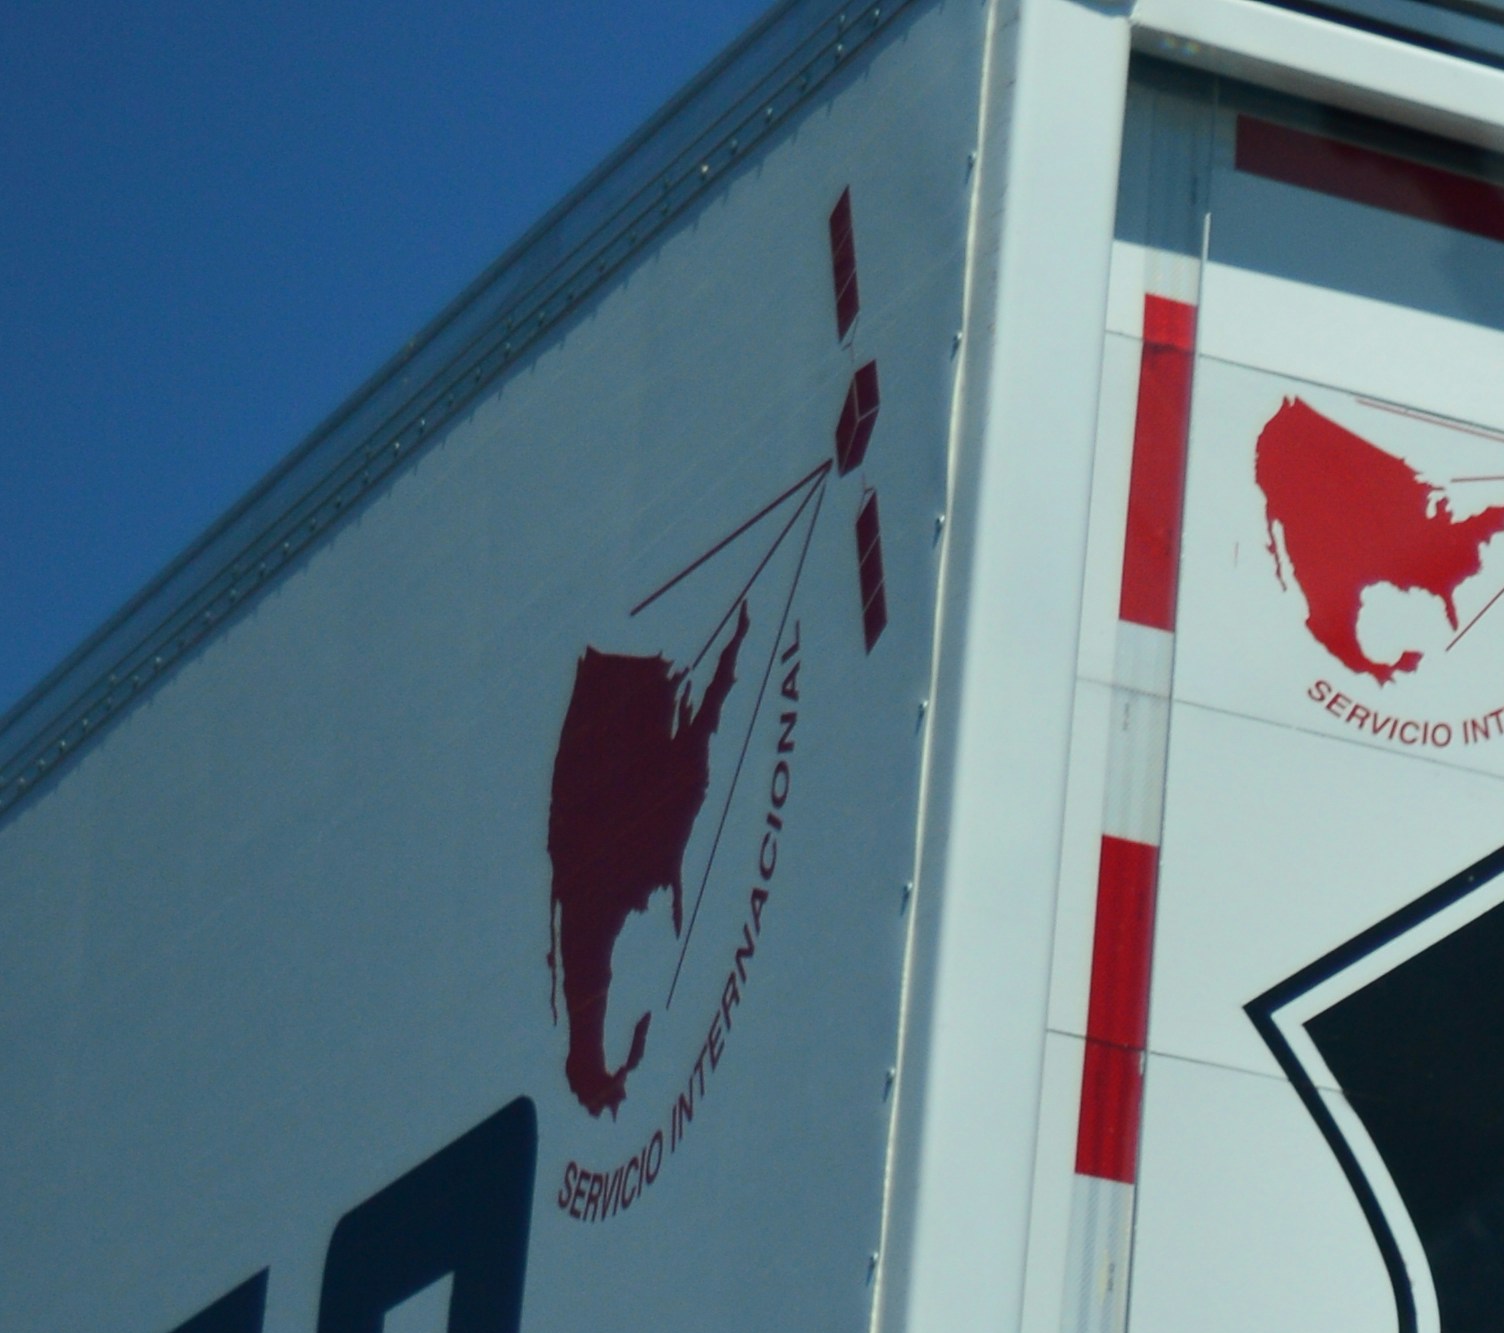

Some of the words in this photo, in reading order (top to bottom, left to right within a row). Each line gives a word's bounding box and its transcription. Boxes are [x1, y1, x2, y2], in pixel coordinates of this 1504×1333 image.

[1307, 679, 1452, 748] SERVICIO
[558, 1130, 664, 1224] SERVICIO
[669, 619, 801, 1155] INTERNACIONAL
